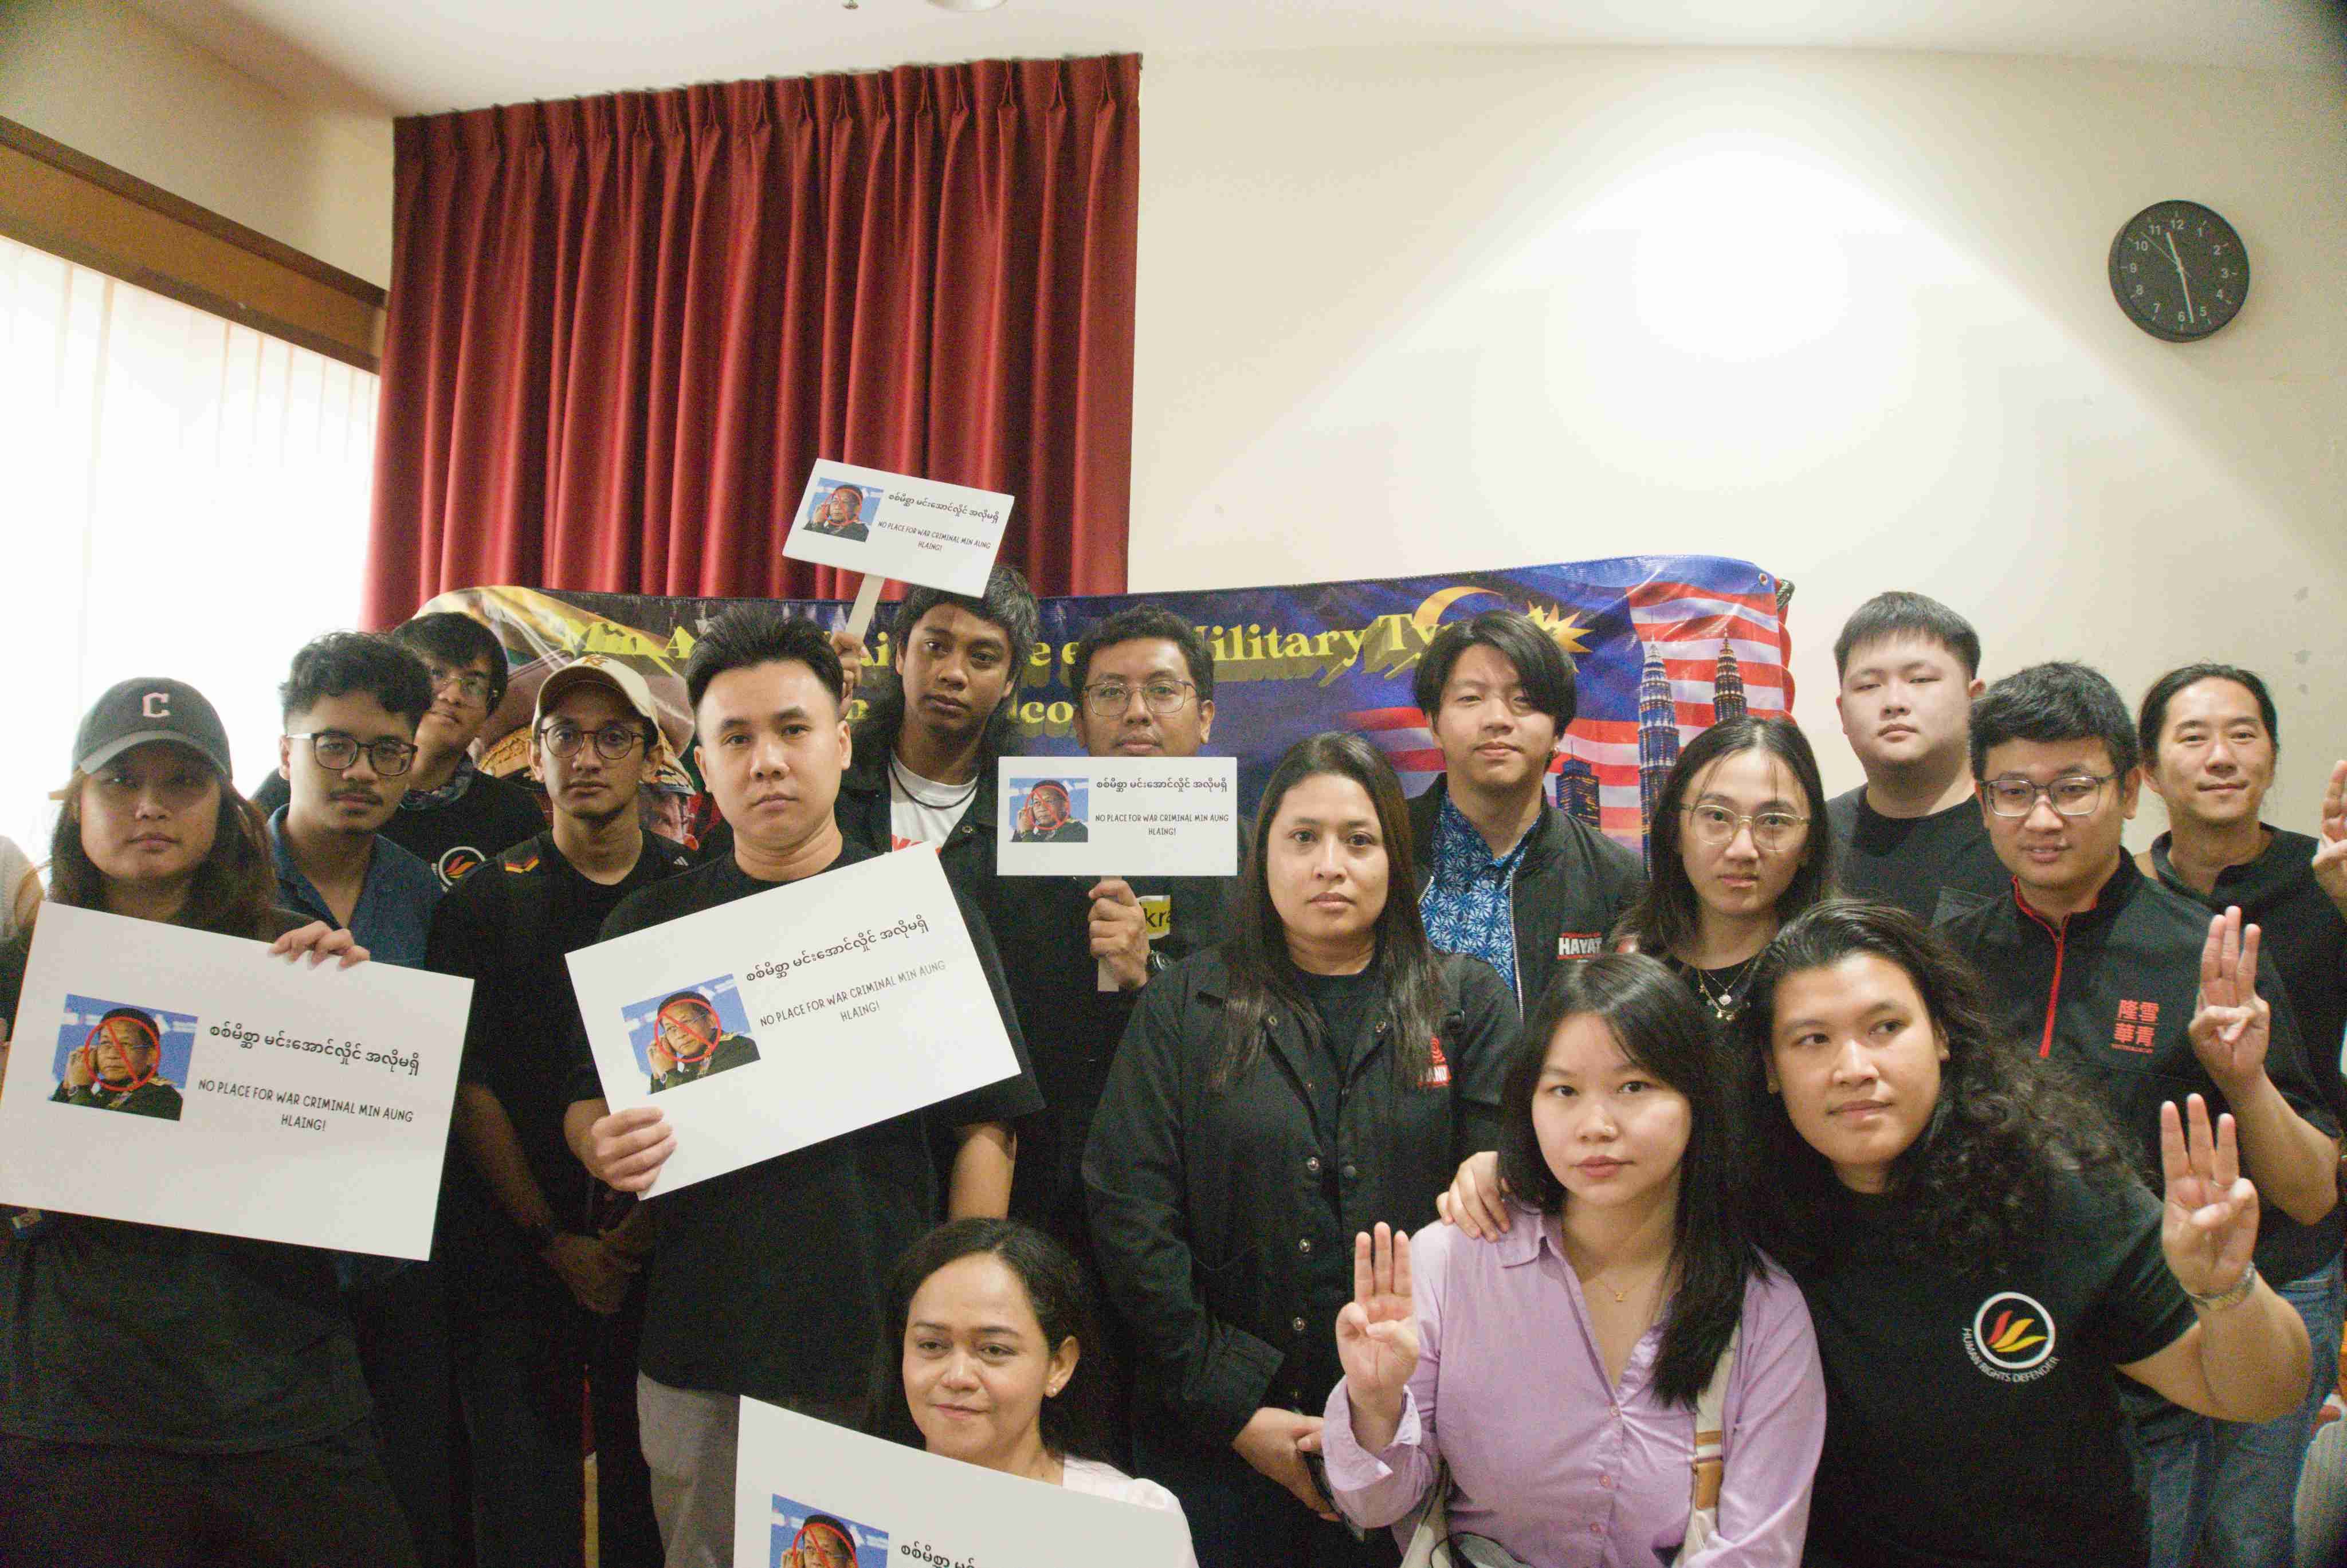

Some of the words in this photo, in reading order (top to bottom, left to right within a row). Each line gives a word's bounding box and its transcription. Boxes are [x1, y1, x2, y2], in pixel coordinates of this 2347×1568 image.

[2171, 219, 2184, 230] 12
[2150, 225, 2161, 235] 11
[2198, 227, 2202, 238] 1
[2136, 241, 2148, 251] 10
[2213, 245, 2221, 256] 2
[2129, 263, 2137, 273] 9
[2221, 268, 2228, 278] 3
[2136, 285, 2144, 294] 8
[2216, 289, 2223, 299] 4
[2153, 303, 2160, 313] 7
[2200, 306, 2207, 316] 5
[2178, 312, 2185, 322] 6
[888, 522, 905, 532] PLACE
[905, 526, 917, 534] FOR
[932, 532, 960, 543] CRIMINAL
[961, 537, 972, 545] MIN
[974, 540, 991, 549] AUNG
[917, 541, 943, 552] HLAING!
[1194, 623, 1367, 667] ilitary
[142, 693, 170, 718] C
[1095, 814, 1105, 822] NO
[1106, 814, 1127, 822] PLACE
[1129, 814, 1141, 822] FOR
[1143, 814, 1157, 822] WAR
[1160, 814, 1192, 822] CRIMINAL
[1195, 814, 1208, 822] MIN
[1210, 814, 1229, 822] AUNG
[1148, 828, 1176, 836] HLAING!
[760, 1015, 775, 1027] NO
[776, 1004, 806, 1021] PLACE
[806, 999, 825, 1013] FOR
[826, 991, 849, 1005] WAR
[850, 976, 896, 999] CRIMINAL
[897, 969, 917, 983] MIN
[919, 960, 947, 976] AUNG
[840, 1000, 880, 1022] HLAING!
[198, 1079, 215, 1091] NO
[217, 1081, 251, 1098] PLACE
[253, 1087, 273, 1101] FOR
[276, 1092, 300, 1105] WAR
[303, 1095, 355, 1114] CRIMINAL
[358, 1104, 380, 1117] MIN
[382, 1107, 414, 1122] AUNG
[281, 1114, 326, 1131] HLAING!
